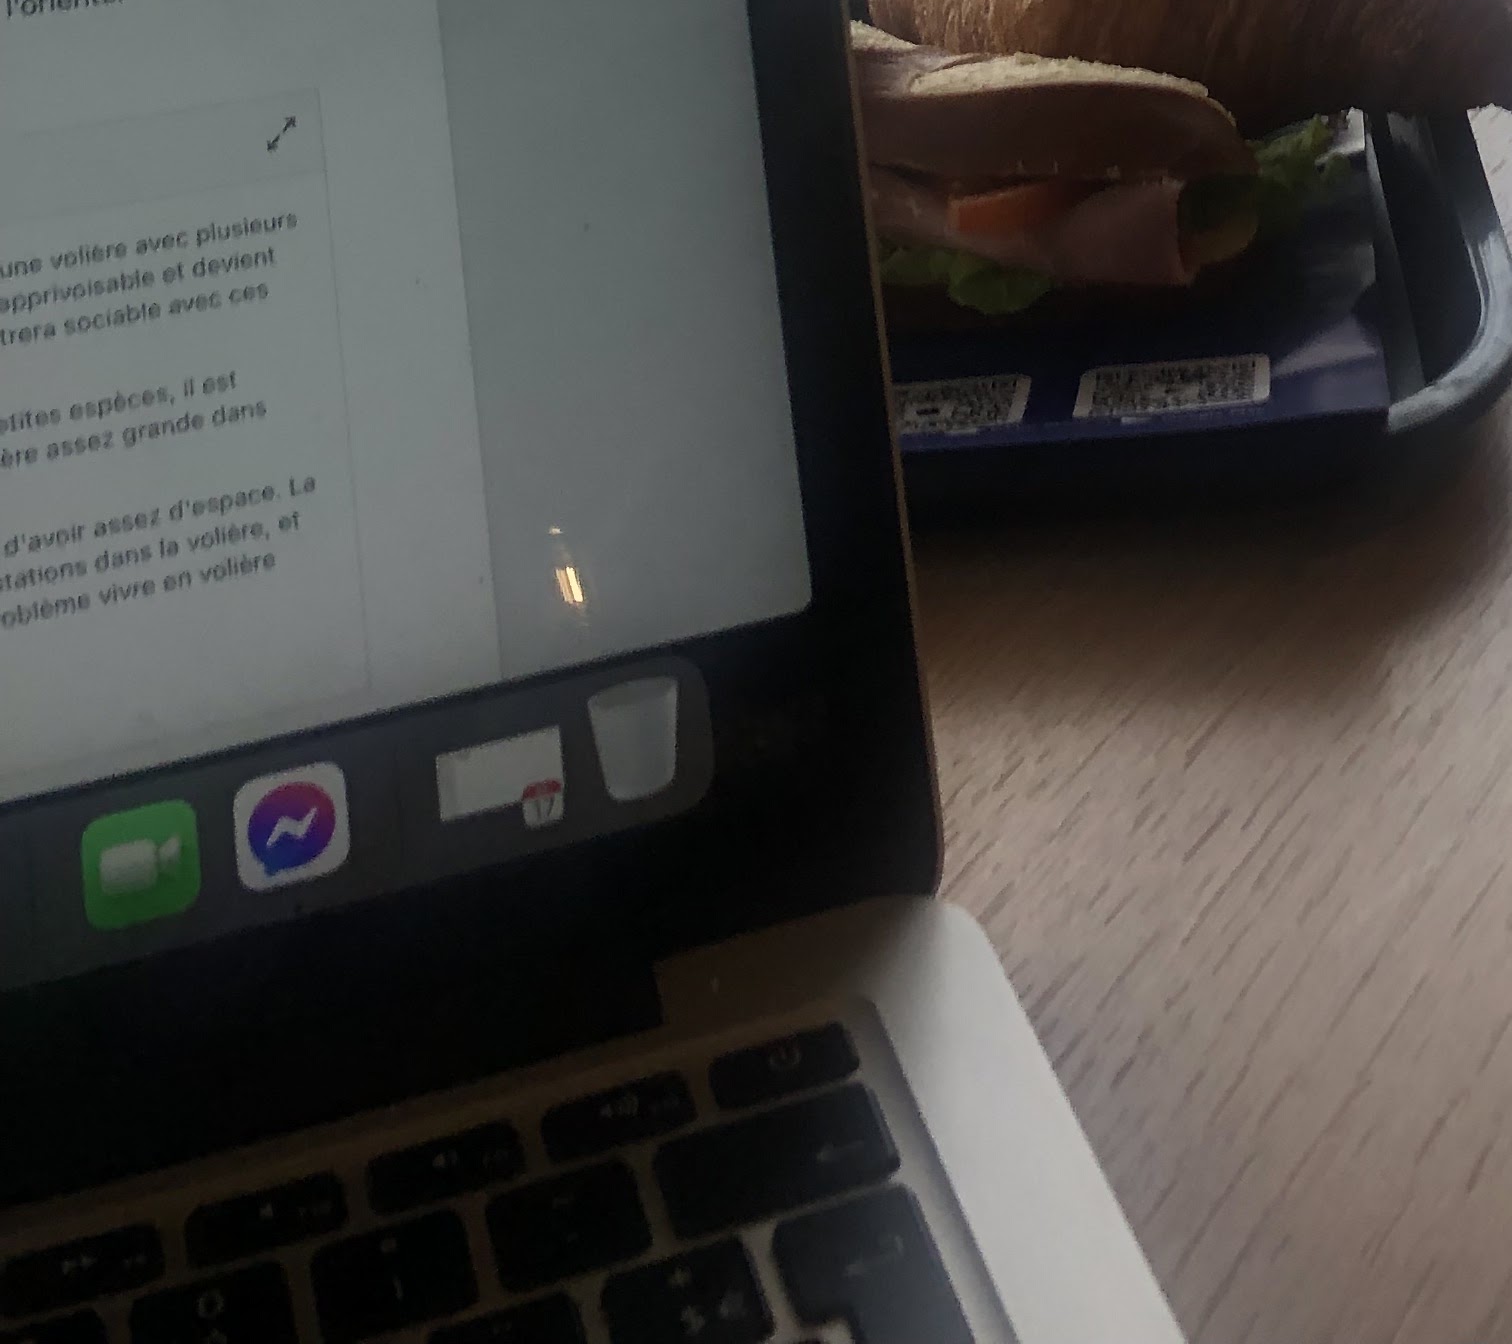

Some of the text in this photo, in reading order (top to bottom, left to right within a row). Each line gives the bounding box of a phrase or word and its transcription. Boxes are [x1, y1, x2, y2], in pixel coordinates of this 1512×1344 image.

[0, 212, 298, 279] une volière avec plusieurs
[162, 262, 184, 284] et
[192, 246, 276, 278] devient
[64, 302, 161, 335] sociable
[168, 290, 222, 316] avec
[228, 282, 269, 304] ces
[69, 386, 175, 419] espèces,
[183, 376, 195, 398] il
[202, 369, 238, 395] est
[46, 428, 113, 461] assez
[122, 410, 205, 448] grande
[212, 399, 267, 428] dans
[4, 521, 85, 559] d'avoir
[93, 506, 160, 539] assez
[94, 545, 152, 574] dans
[159, 538, 179, 559] la
[187, 520, 271, 553] volière,
[99, 575, 156, 607] vivre
[162, 569, 192, 593] en
[199, 551, 276, 584] volière
